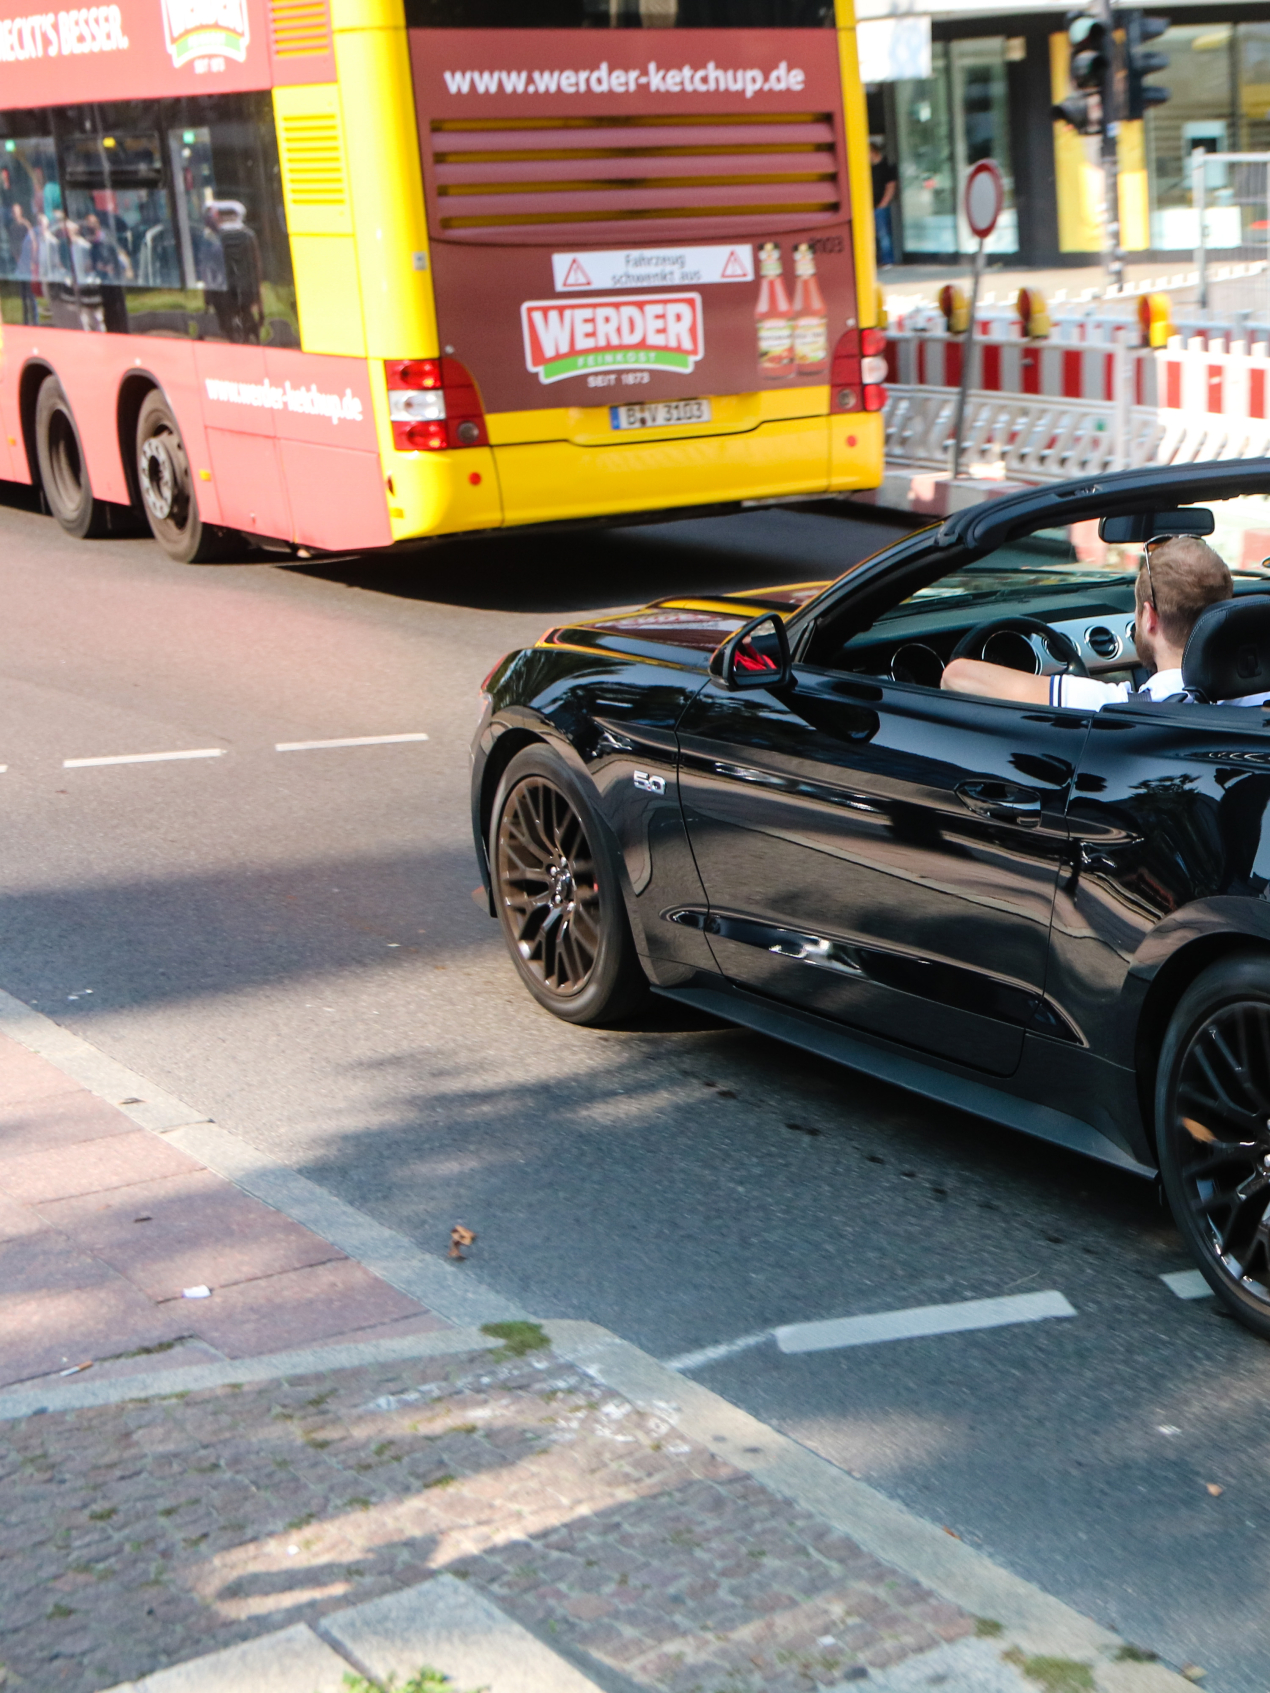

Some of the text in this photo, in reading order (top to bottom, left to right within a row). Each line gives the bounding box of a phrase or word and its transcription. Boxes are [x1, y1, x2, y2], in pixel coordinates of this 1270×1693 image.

[0, 4, 128, 62] ECKT'S BESSER.
[444, 61, 805, 99] www.werder-ketchup.de
[624, 252, 686, 269] Fahrzeug
[611, 269, 702, 287] schwenkt aus
[531, 302, 695, 359] WERDER
[576, 352, 657, 368] FEINKOST
[587, 374, 618, 389] SEIT
[626, 408, 637, 425] B
[633, 769, 667, 796] 5.0
